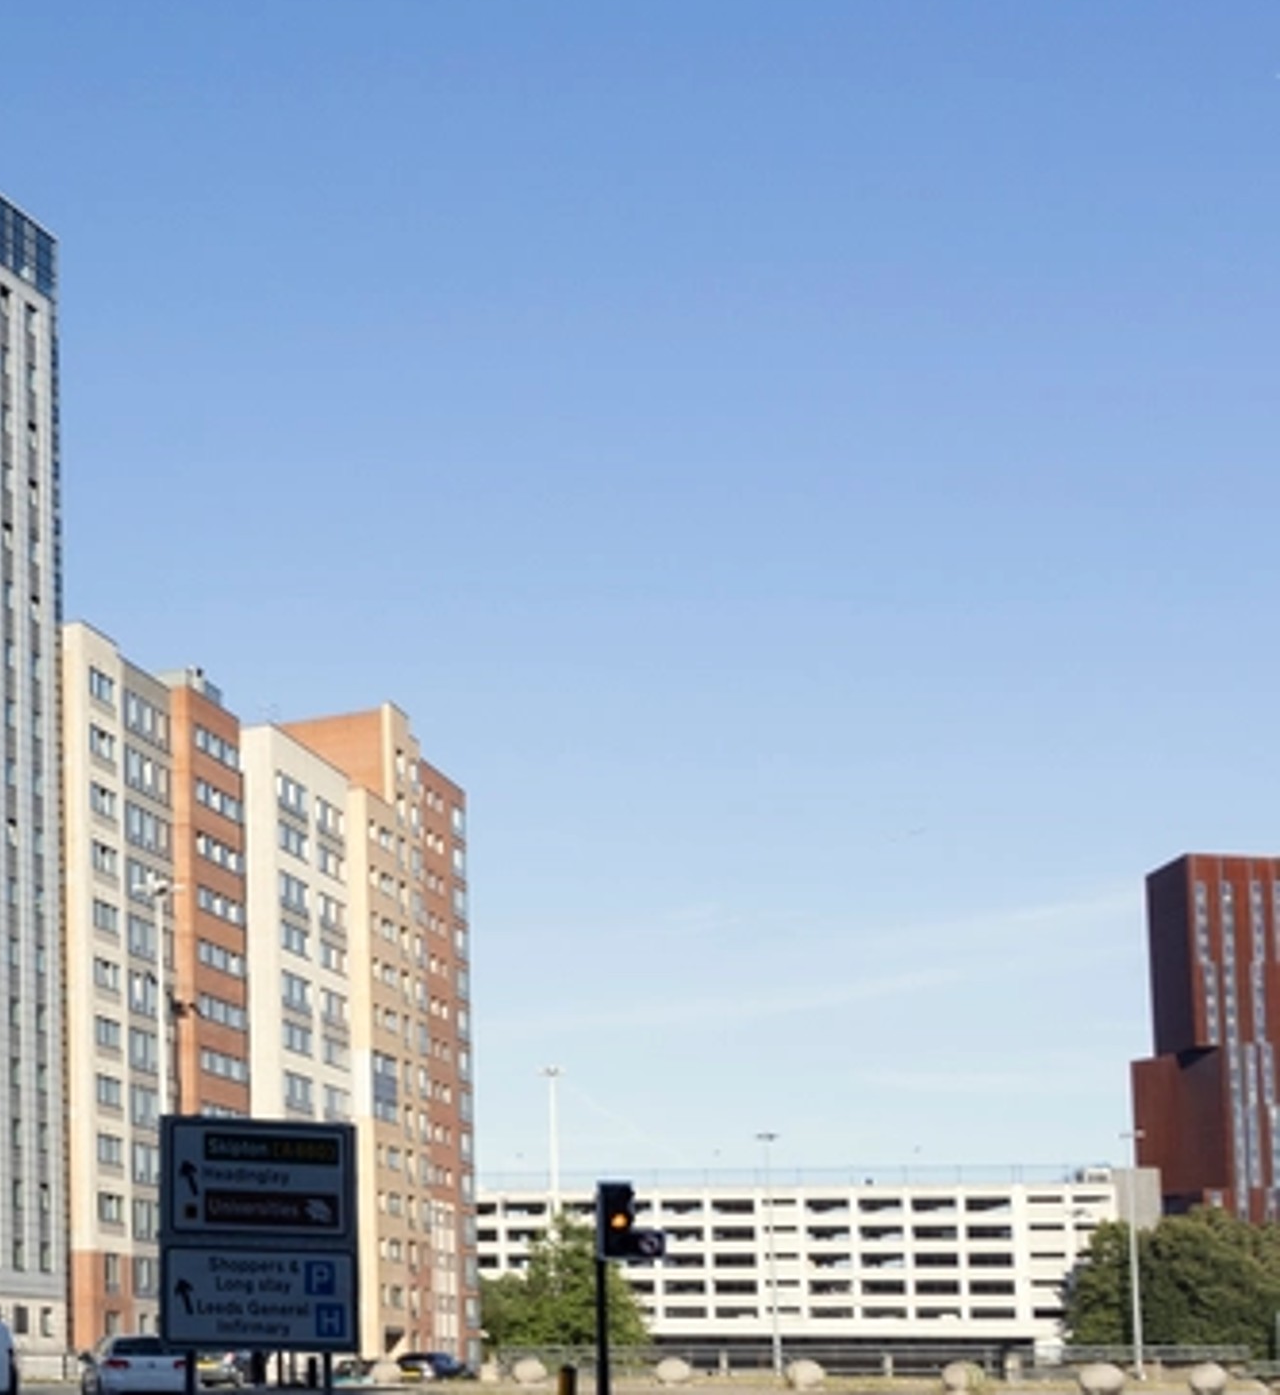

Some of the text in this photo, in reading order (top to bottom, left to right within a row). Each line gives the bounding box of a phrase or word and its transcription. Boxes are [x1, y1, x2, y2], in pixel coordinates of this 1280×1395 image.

[208, 1256, 285, 1274] Shoppers
[215, 1276, 291, 1294] Long stay
[311, 1265, 331, 1293] P
[196, 1299, 310, 1317] Leeds General
[319, 1308, 341, 1335] H
